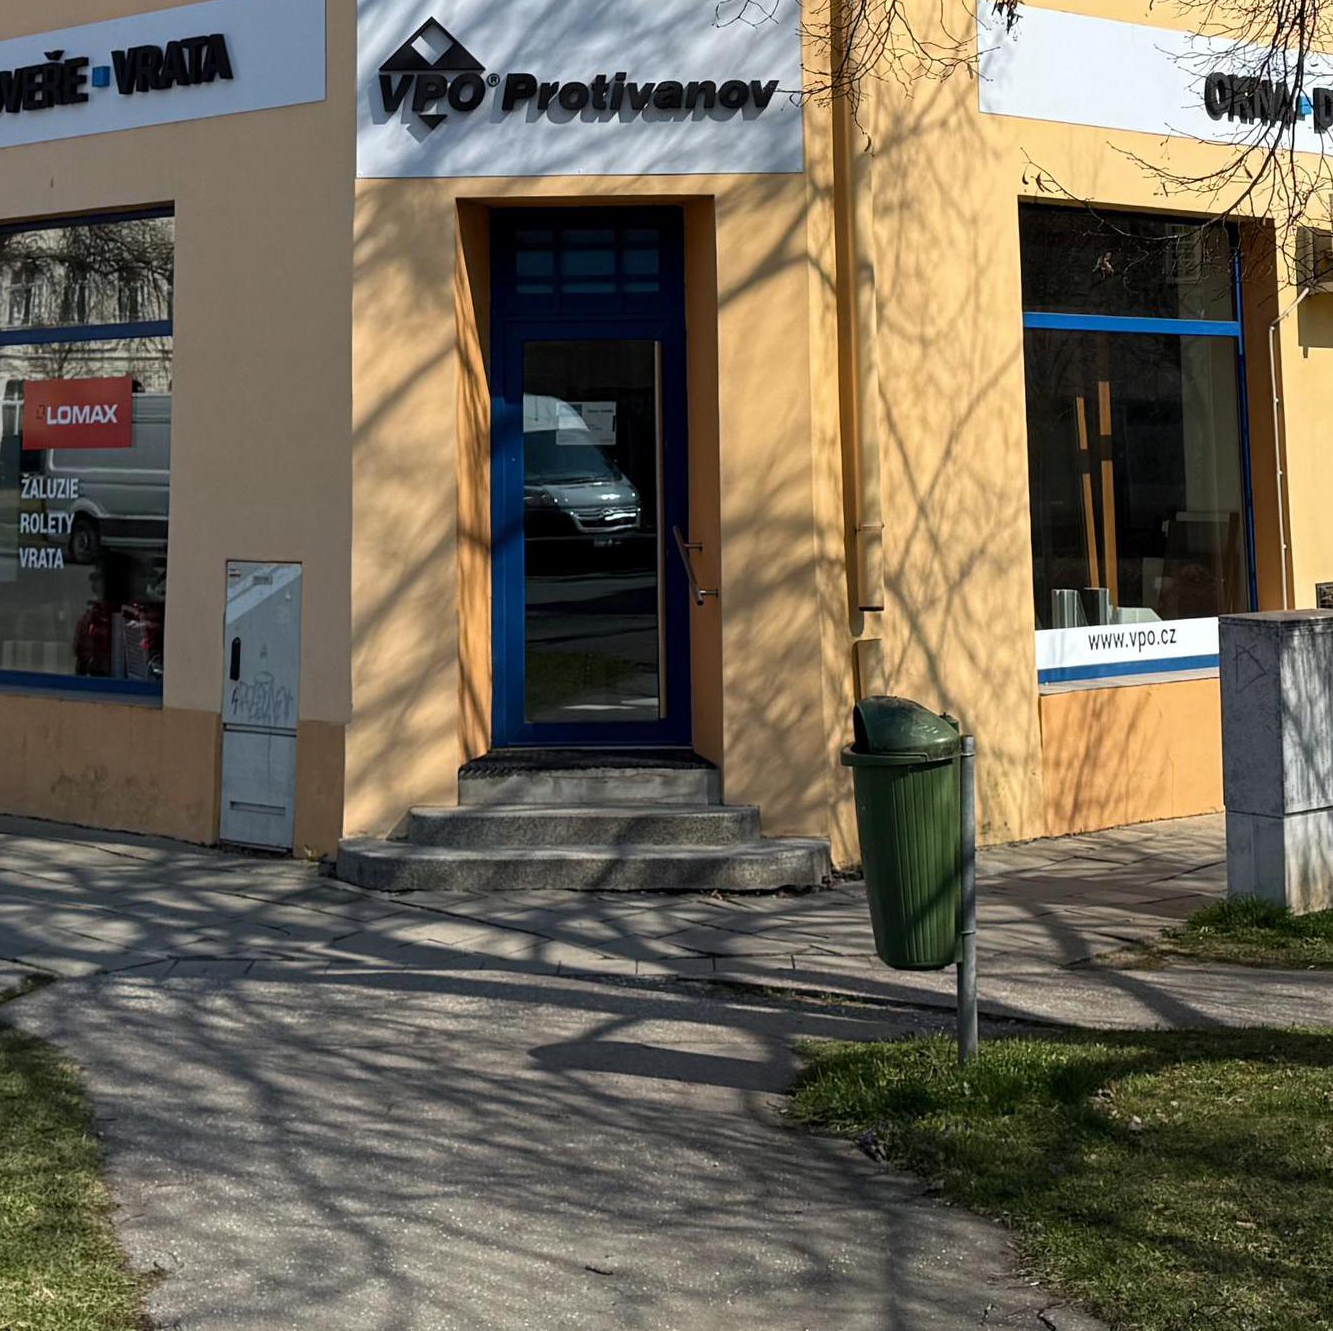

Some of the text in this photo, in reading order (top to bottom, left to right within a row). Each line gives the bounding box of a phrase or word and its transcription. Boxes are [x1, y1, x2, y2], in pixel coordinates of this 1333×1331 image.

[111, 33, 234, 95] VRATA
[501, 72, 780, 112] Protivanov
[46, 404, 118, 425] LOMAX
[21, 473, 79, 499] ŽALUZIE
[20, 513, 75, 534] ROLETY
[19, 547, 65, 569] VRATA
[1088, 628, 1178, 653] www.vpo.cz
